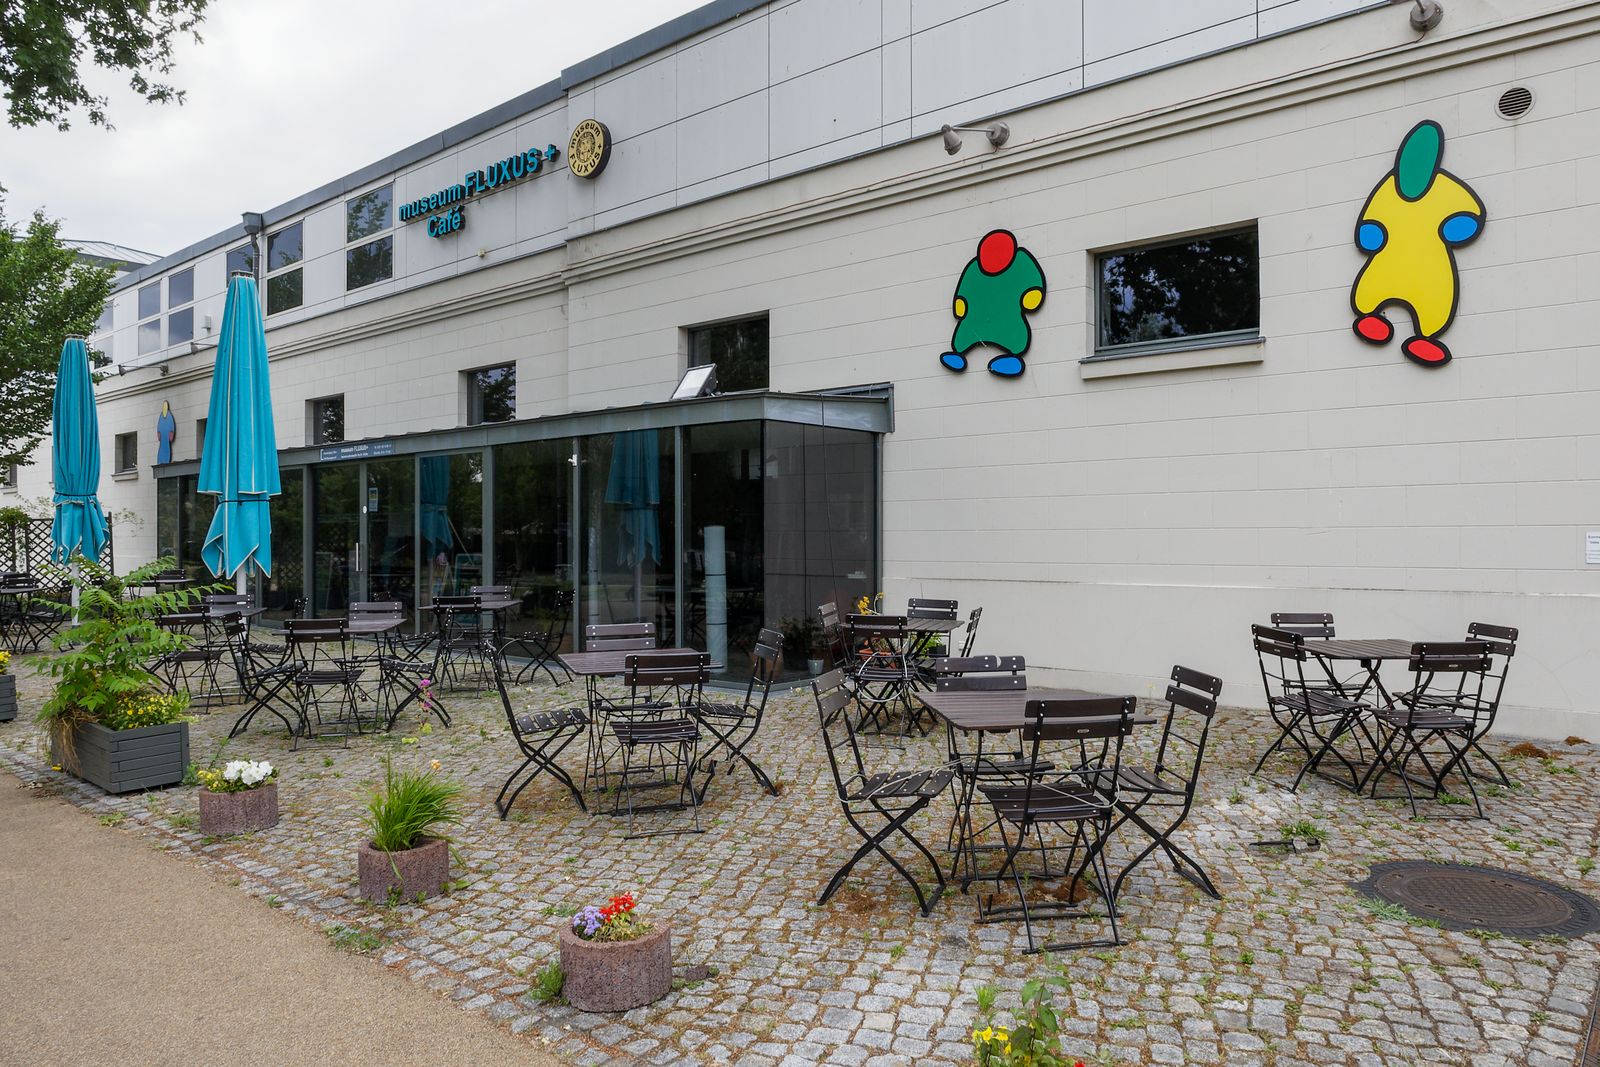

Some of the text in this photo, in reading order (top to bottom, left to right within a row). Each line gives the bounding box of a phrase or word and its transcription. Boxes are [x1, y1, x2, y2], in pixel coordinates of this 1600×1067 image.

[571, 122, 601, 149] museum
[399, 183, 463, 221] museum
[427, 205, 463, 238] Café
